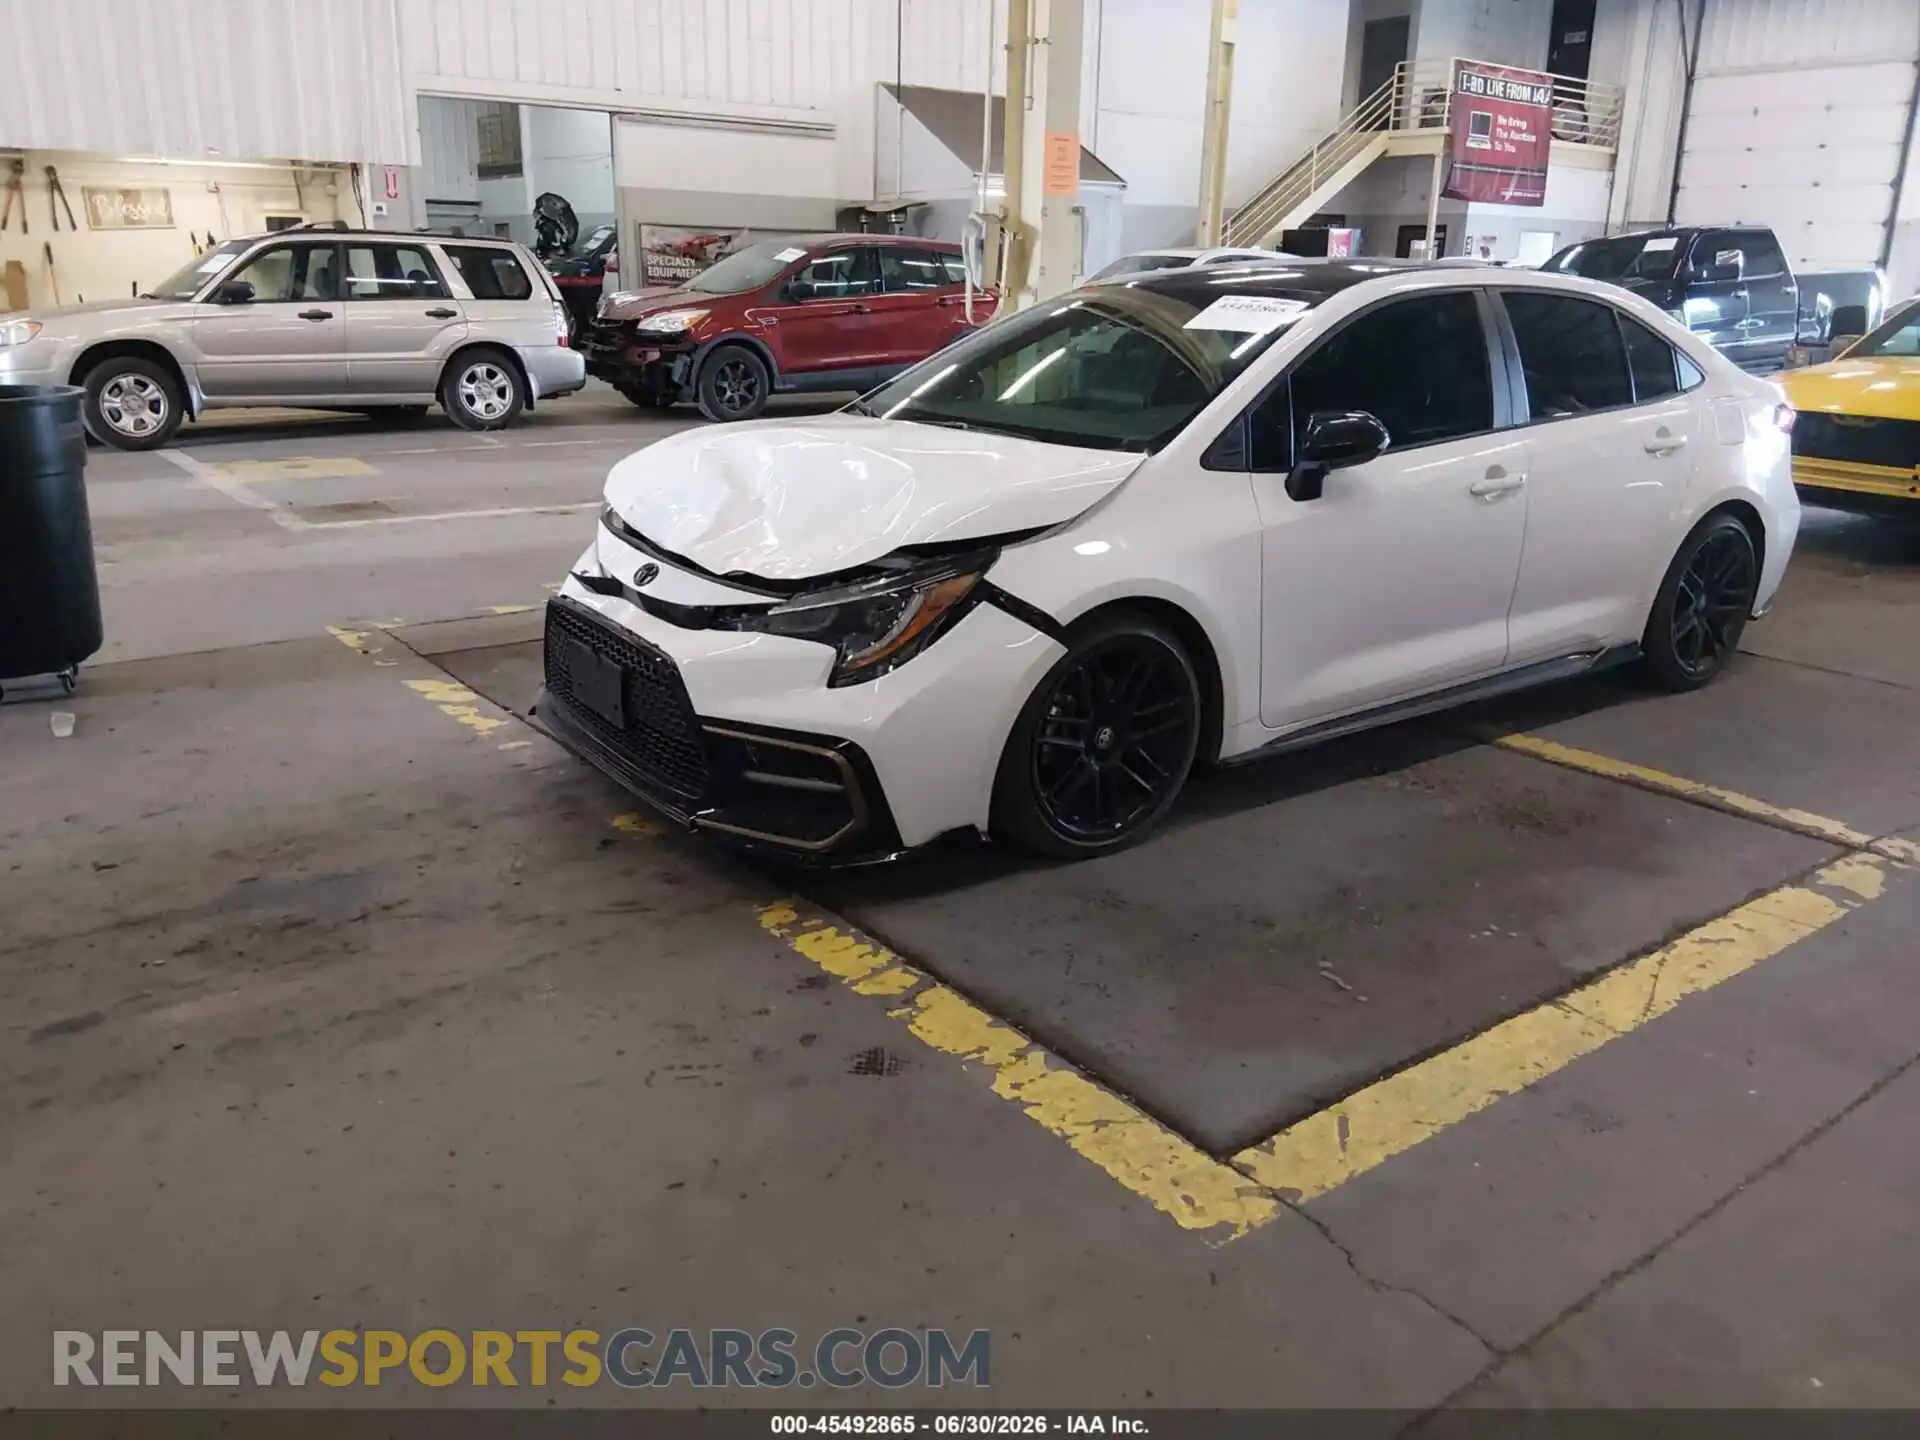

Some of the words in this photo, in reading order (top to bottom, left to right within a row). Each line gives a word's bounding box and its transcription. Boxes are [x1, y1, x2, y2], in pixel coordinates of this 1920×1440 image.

[1487, 79, 1505, 97] LIVE
[1506, 83, 1532, 102] FROM
[647, 255, 696, 267] SPECIALTY
